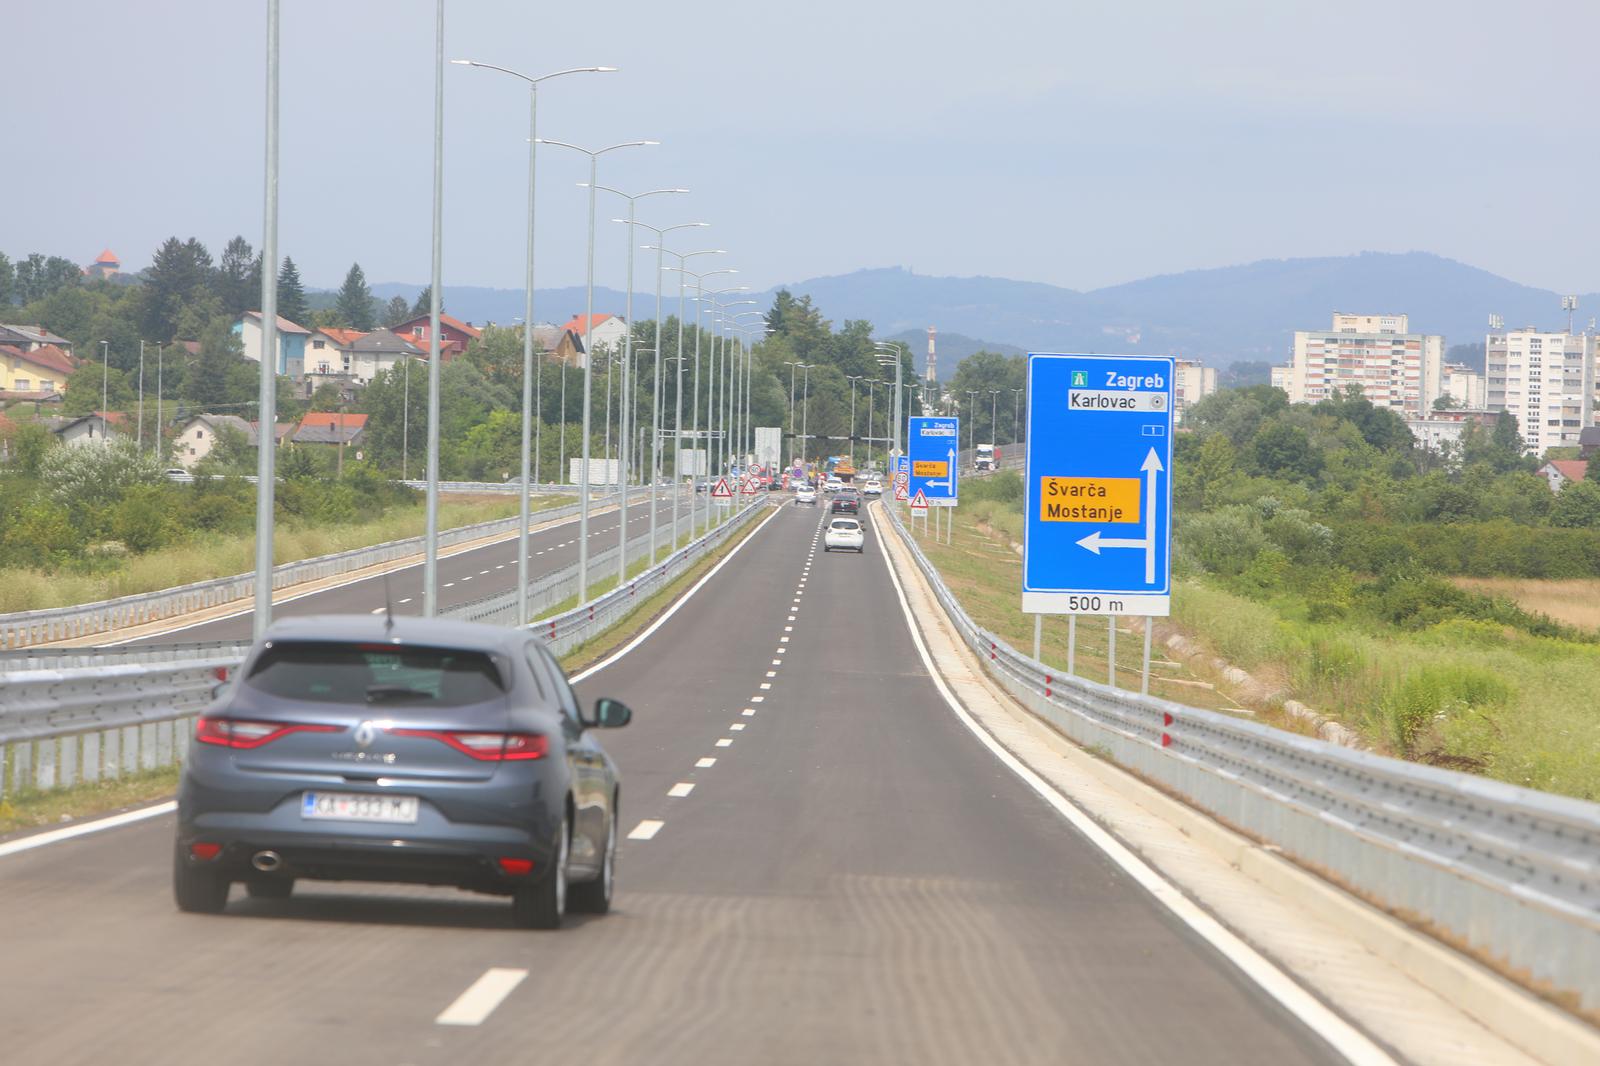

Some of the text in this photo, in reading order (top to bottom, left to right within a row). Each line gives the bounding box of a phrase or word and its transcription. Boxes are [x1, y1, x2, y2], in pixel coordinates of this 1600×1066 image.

[1106, 371, 1165, 391] Zagreb
[1071, 393, 1137, 409] Karlovac
[1048, 477, 1107, 497] Švarča
[1047, 504, 1123, 523] Mostanje
[1069, 596, 1124, 611] 500 m
